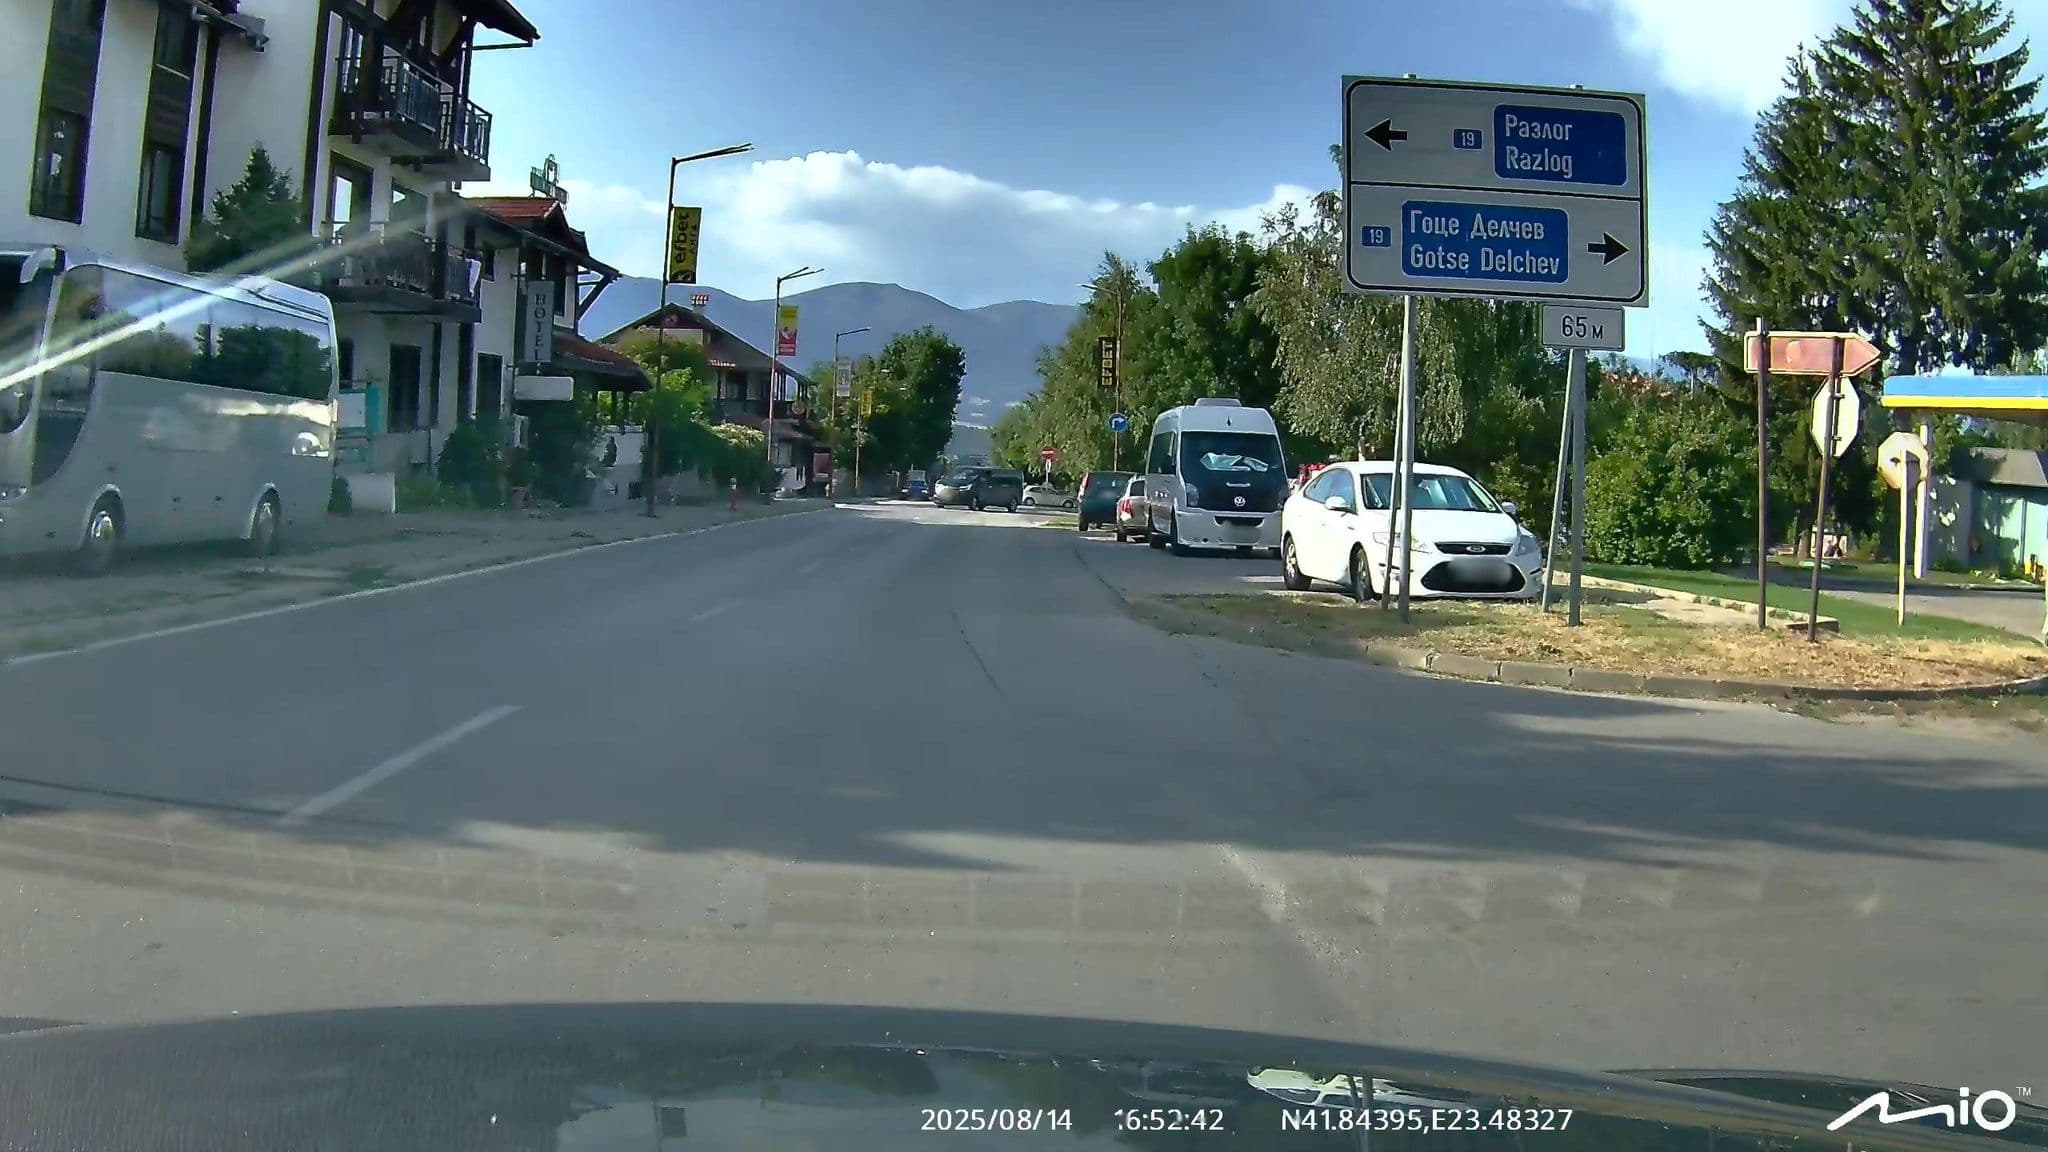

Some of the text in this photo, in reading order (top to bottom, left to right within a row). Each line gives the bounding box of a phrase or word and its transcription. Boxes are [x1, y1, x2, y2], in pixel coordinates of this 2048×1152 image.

[1461, 131, 1475, 147] 19
[1505, 113, 1573, 141] Разлог
[1505, 145, 1573, 179] Razlog
[1369, 228, 1384, 244] 19
[1410, 209, 1545, 240] Гоце Делчев
[1410, 243, 1560, 275] Gotse Delchev
[534, 294, 546, 361] HOTEL
[1562, 315, 1588, 338] 65
